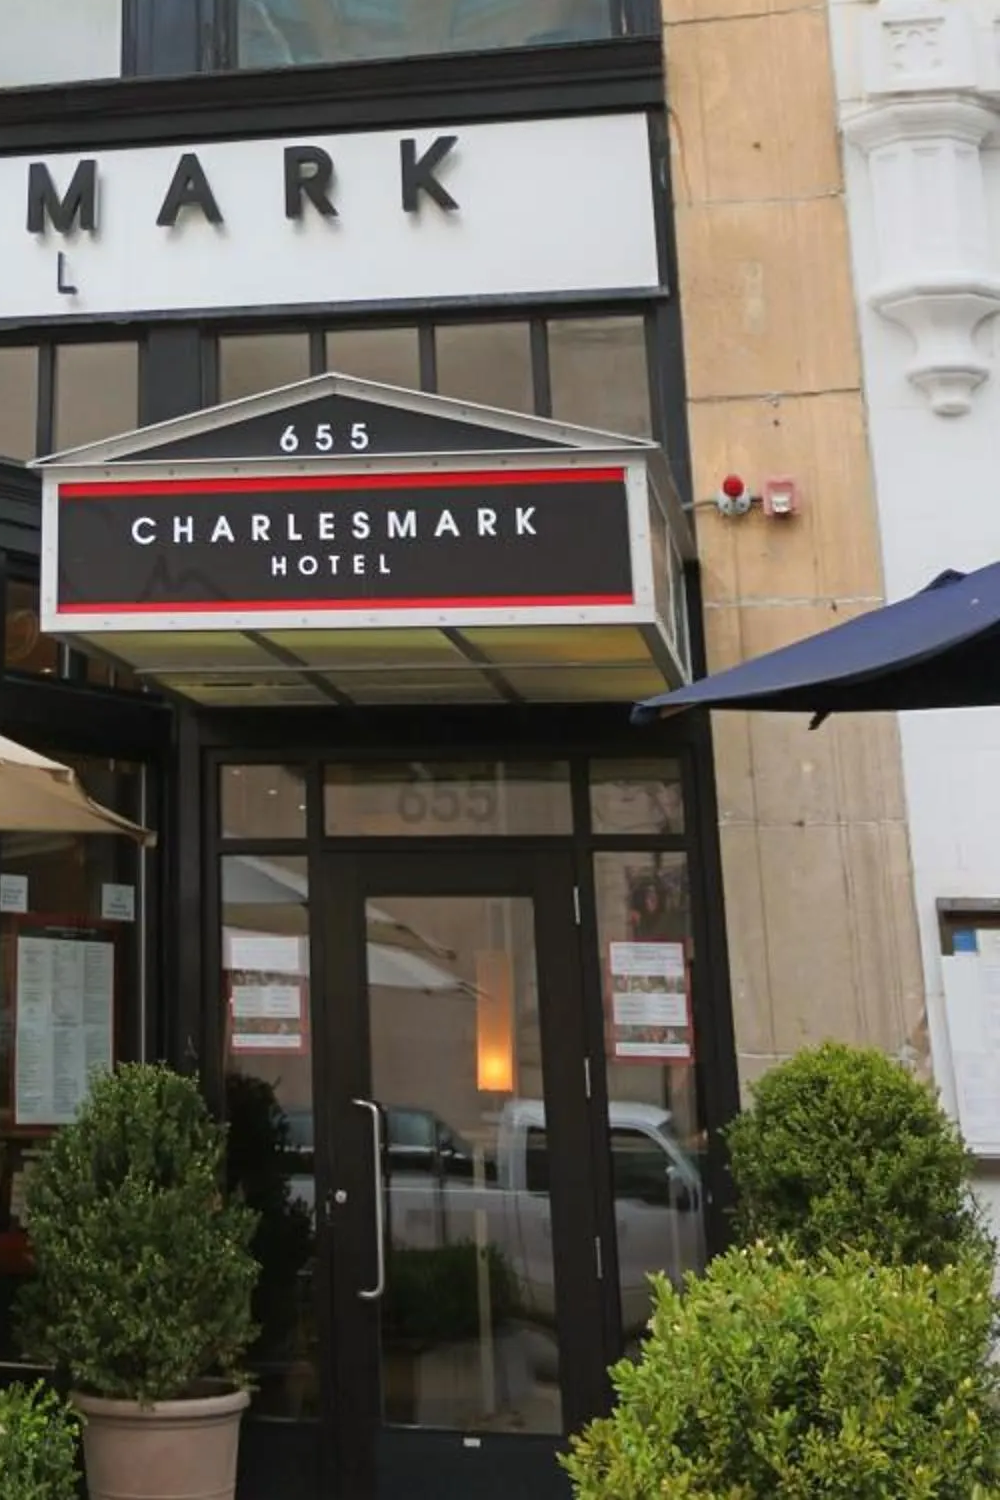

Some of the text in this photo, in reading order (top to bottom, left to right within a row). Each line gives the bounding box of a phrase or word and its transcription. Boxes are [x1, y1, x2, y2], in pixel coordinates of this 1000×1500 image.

[279, 423, 369, 453] 655
[130, 507, 538, 545] CHARLESMARK
[271, 554, 391, 577] HOTEL
